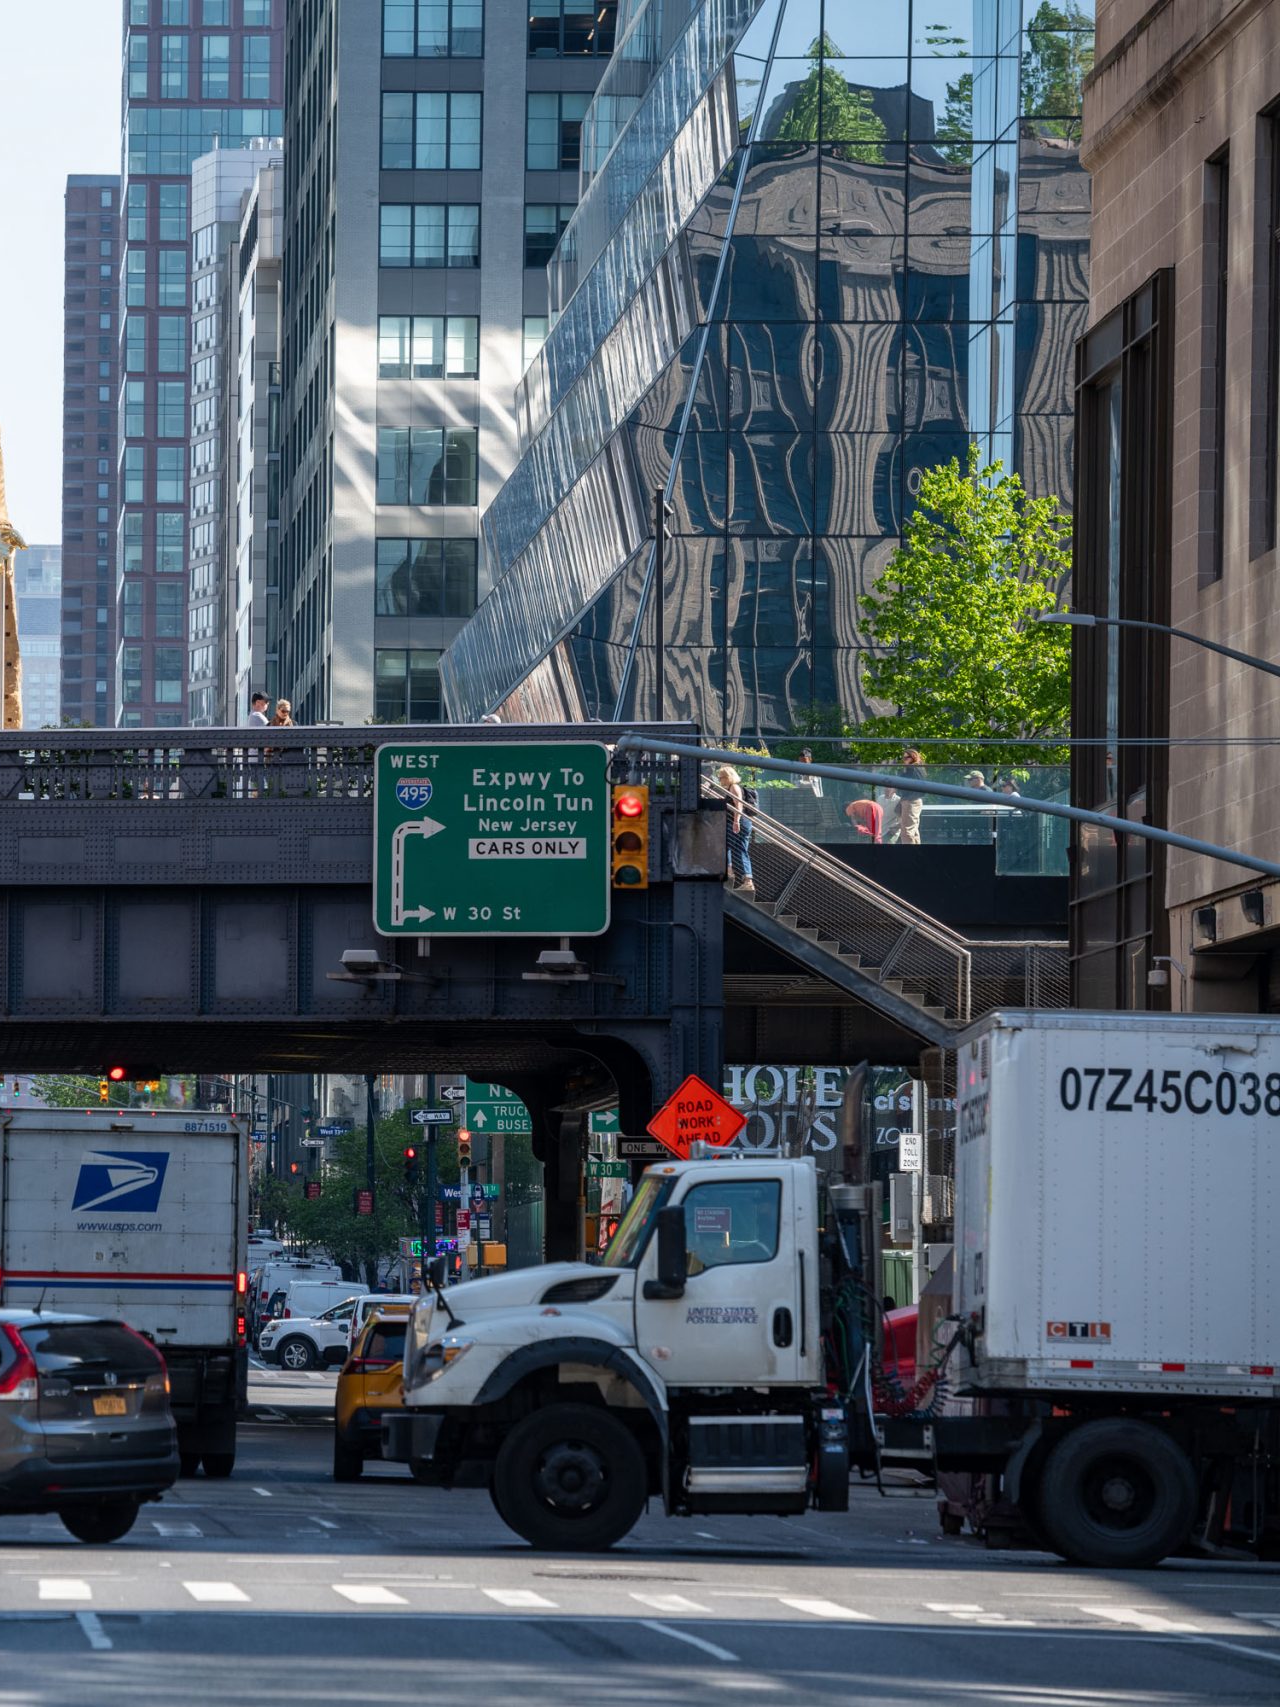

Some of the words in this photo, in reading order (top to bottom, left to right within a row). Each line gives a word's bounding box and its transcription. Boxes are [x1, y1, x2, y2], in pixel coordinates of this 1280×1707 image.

[391, 755, 439, 768] WEST
[472, 769, 551, 790] Expwy
[560, 768, 584, 786] To
[399, 786, 429, 802] 495
[463, 795, 545, 811] Lincoln
[553, 794, 593, 811] Tun
[478, 819, 512, 832] New
[520, 818, 577, 834] Jersey
[476, 842, 525, 855] CARS
[532, 841, 580, 855] ONLY
[443, 907, 456, 920] W
[468, 907, 491, 920] 30
[503, 907, 521, 920] St
[489, 1084, 514, 1097] Ne
[723, 1065, 843, 1107] HOLE
[1059, 1067, 1280, 1117] 07Z45C038
[677, 1100, 713, 1114] ROAD
[184, 1122, 227, 1132] 8871519
[497, 1120, 532, 1130] BUSE
[679, 1116, 714, 1129] WORK
[677, 1132, 721, 1146] AHEAD
[904, 1137, 917, 1146] END
[626, 1143, 646, 1153] ONE
[655, 1143, 669, 1153] WA
[904, 1149, 918, 1157] TOLL
[589, 1163, 598, 1176] W
[600, 1163, 612, 1176] 30
[444, 1188, 462, 1198] Wes
[76, 1221, 162, 1233] www.usps.com
[688, 1306, 723, 1315] UNITED
[724, 1306, 756, 1315] STATES
[686, 1315, 720, 1324] POSTAL
[722, 1315, 759, 1324] SERVICE
[1049, 1324, 1108, 1338] CTL
